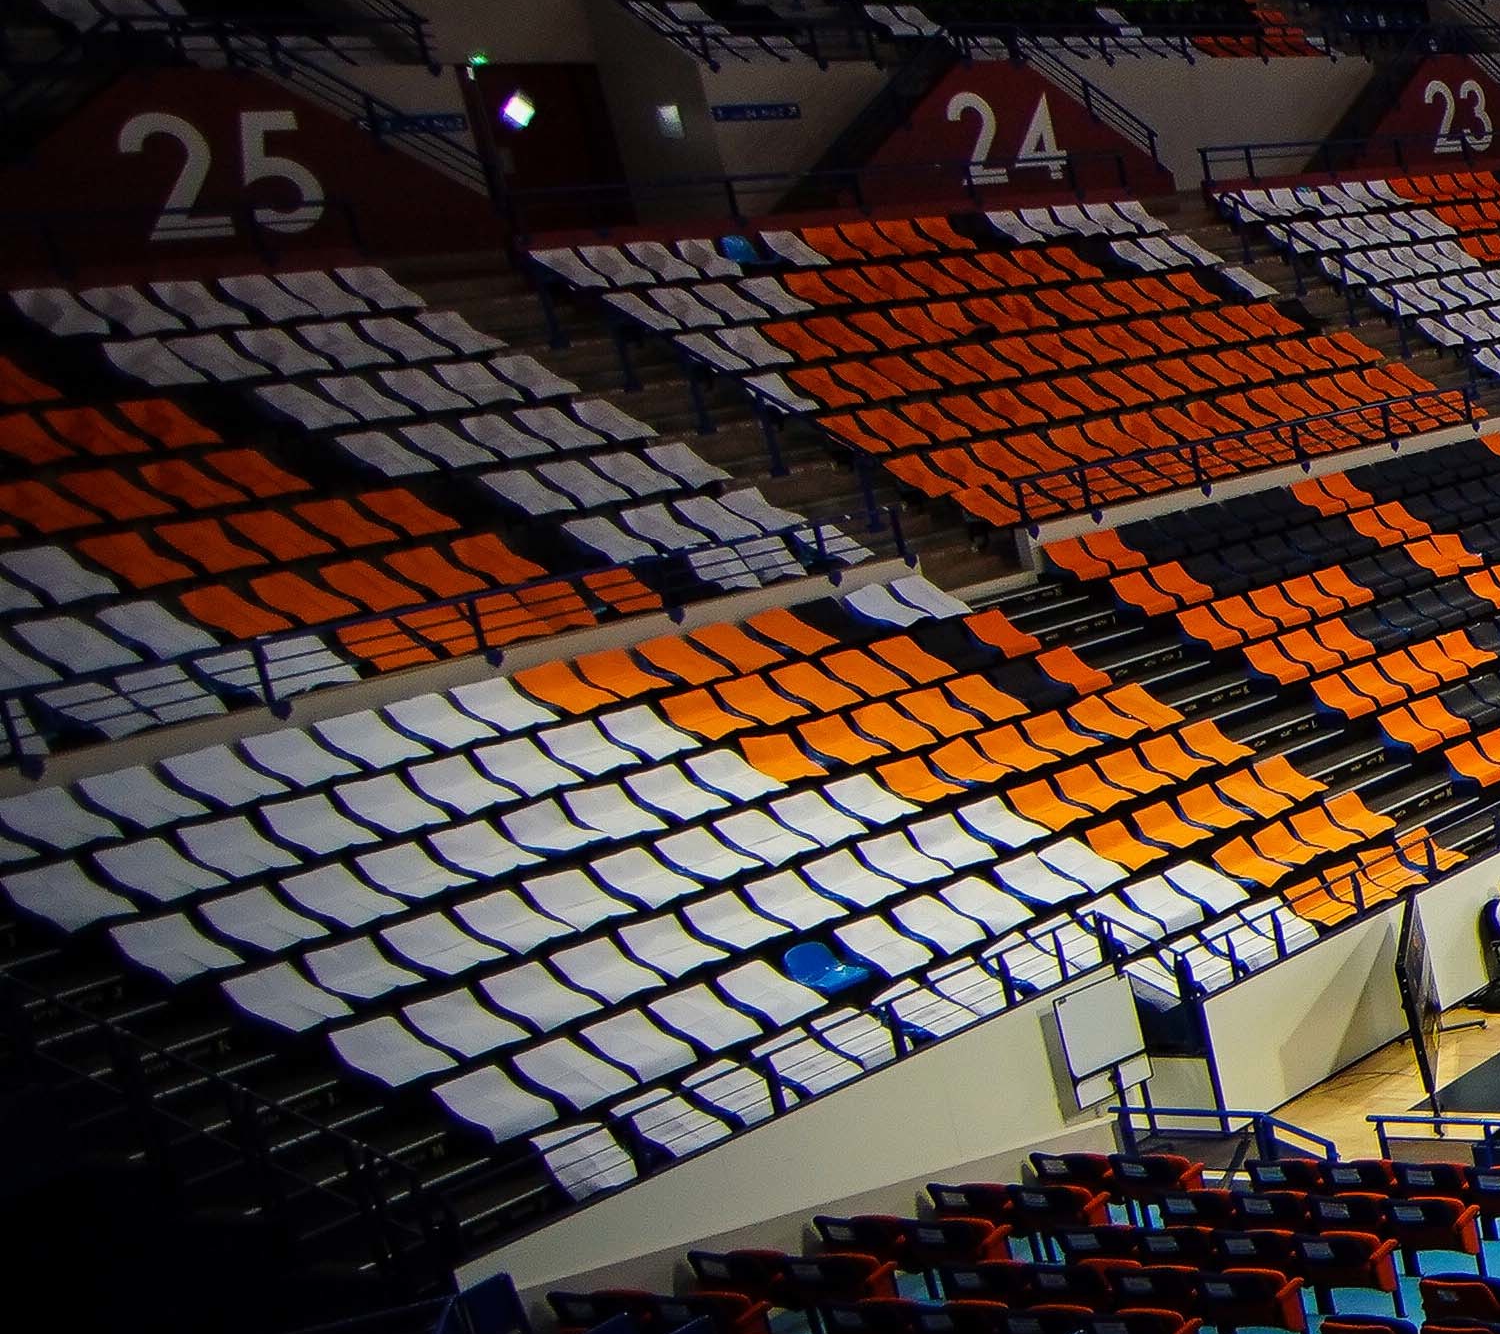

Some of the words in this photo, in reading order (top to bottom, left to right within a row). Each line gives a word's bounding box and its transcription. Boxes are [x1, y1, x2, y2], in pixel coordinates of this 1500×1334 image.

[945, 90, 1070, 187] 24
[1423, 79, 1494, 155] 23
[117, 110, 326, 243] 25
